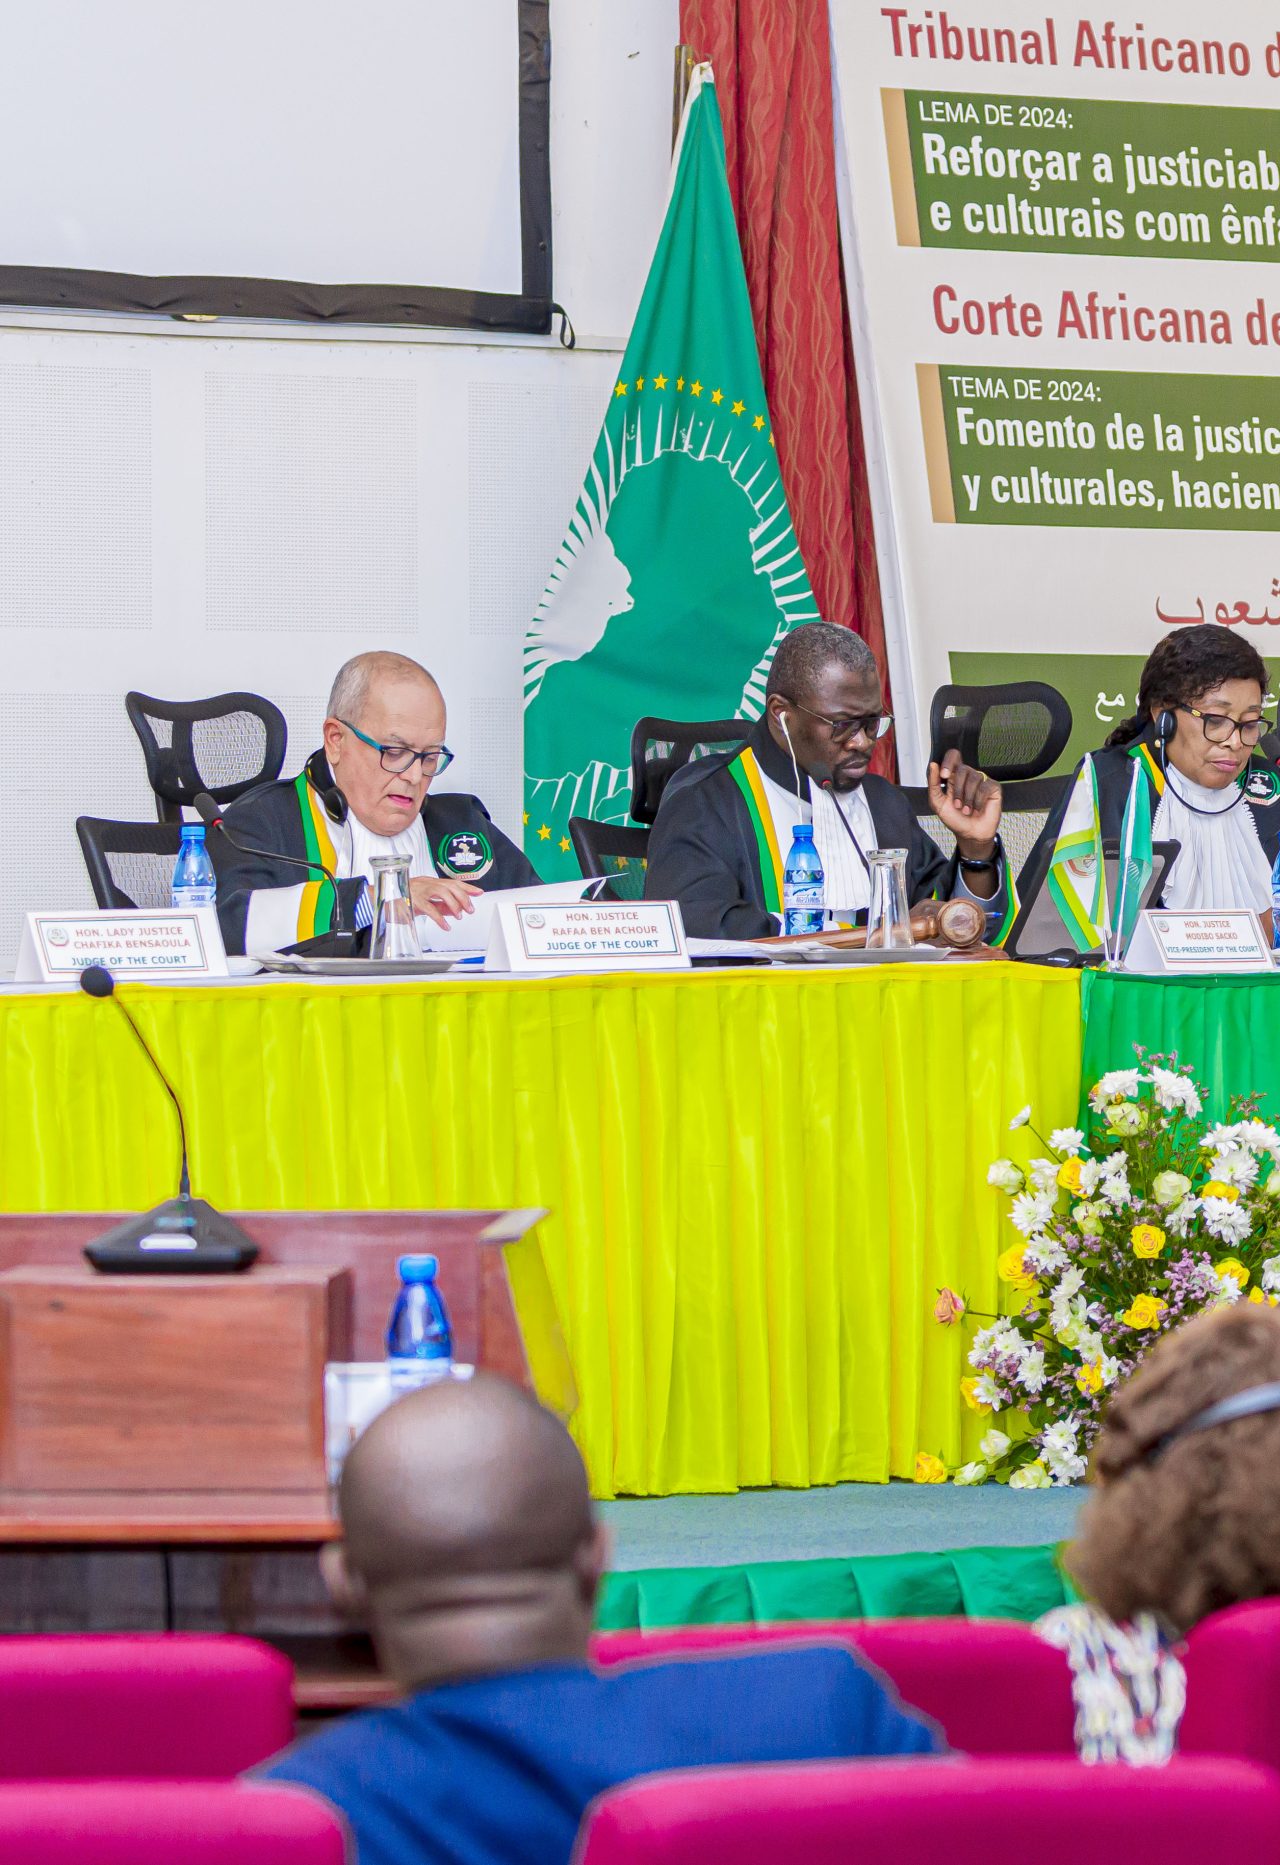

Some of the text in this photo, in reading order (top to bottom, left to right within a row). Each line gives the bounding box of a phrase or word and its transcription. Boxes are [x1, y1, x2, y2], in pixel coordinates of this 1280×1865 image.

[880, 8, 1057, 65] Tribunal
[1074, 20, 1249, 76] Africano
[919, 101, 1073, 128] LEMA DE 2024:
[923, 133, 1081, 191] Reforçar
[1093, 153, 1113, 182] a
[930, 201, 951, 231] e
[963, 194, 1124, 239] culturais
[1136, 211, 1210, 242] com
[933, 284, 1041, 337] Corte
[1058, 291, 1231, 343] Africana
[948, 376, 1101, 402] TEMA DE 2024:
[957, 407, 1095, 449] Fomento
[1106, 413, 1144, 450] de
[1154, 414, 1184, 451] la
[962, 475, 980, 511] y
[992, 467, 1164, 511] culturales,
[1095, 691, 1126, 722] مع
[566, 911, 639, 921] HON. JUSTICE
[1203, 920, 1231, 928] JUSTICE
[75, 926, 183, 938] HON. LADY JUSTICE
[552, 925, 658, 936] RAFAA BEN ACHOUR
[74, 939, 123, 949] CHAFIKA
[547, 939, 659, 951] JUDGE OF THE COURT
[1239, 945, 1259, 953] COURT
[72, 955, 187, 966] JUDGE OF THE COURT
